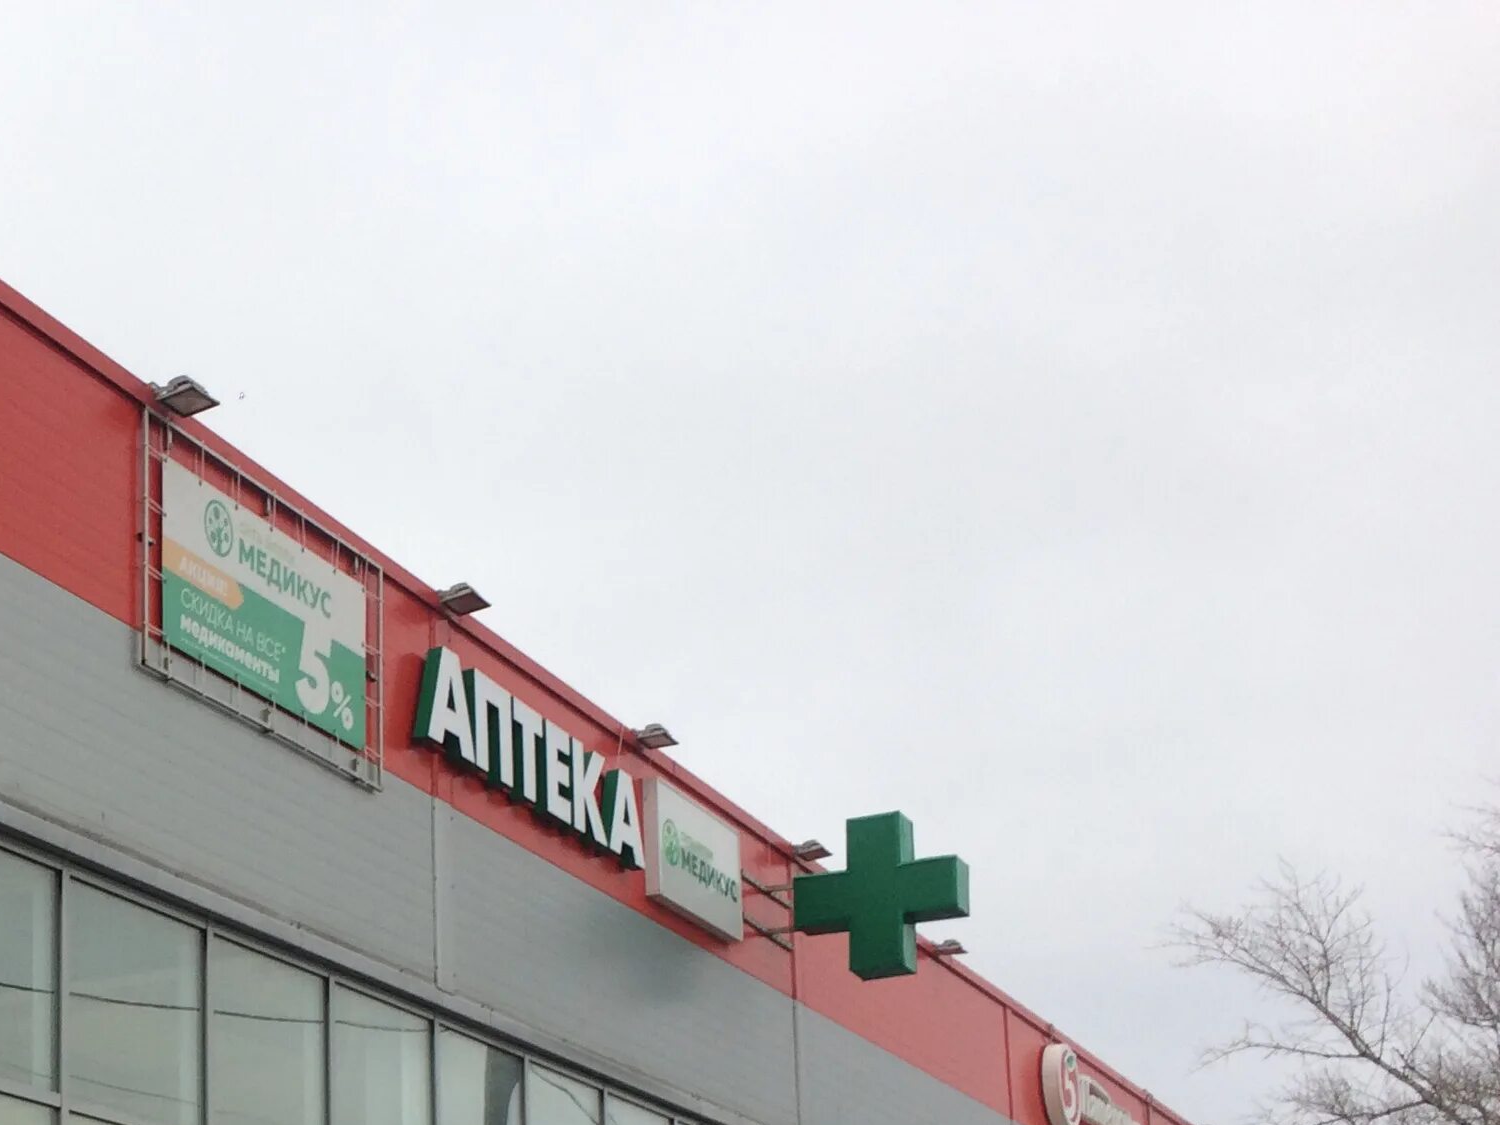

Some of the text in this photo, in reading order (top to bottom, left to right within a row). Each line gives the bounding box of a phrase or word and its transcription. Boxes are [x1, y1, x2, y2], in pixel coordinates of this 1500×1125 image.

[238, 537, 333, 619] МЕДИКУС
[180, 587, 234, 635] СКИДКА
[236, 620, 255, 648] НА
[180, 613, 280, 684] медикаменты
[425, 645, 646, 870] АПТЕКА
[680, 847, 738, 904] МЕДИКУС
